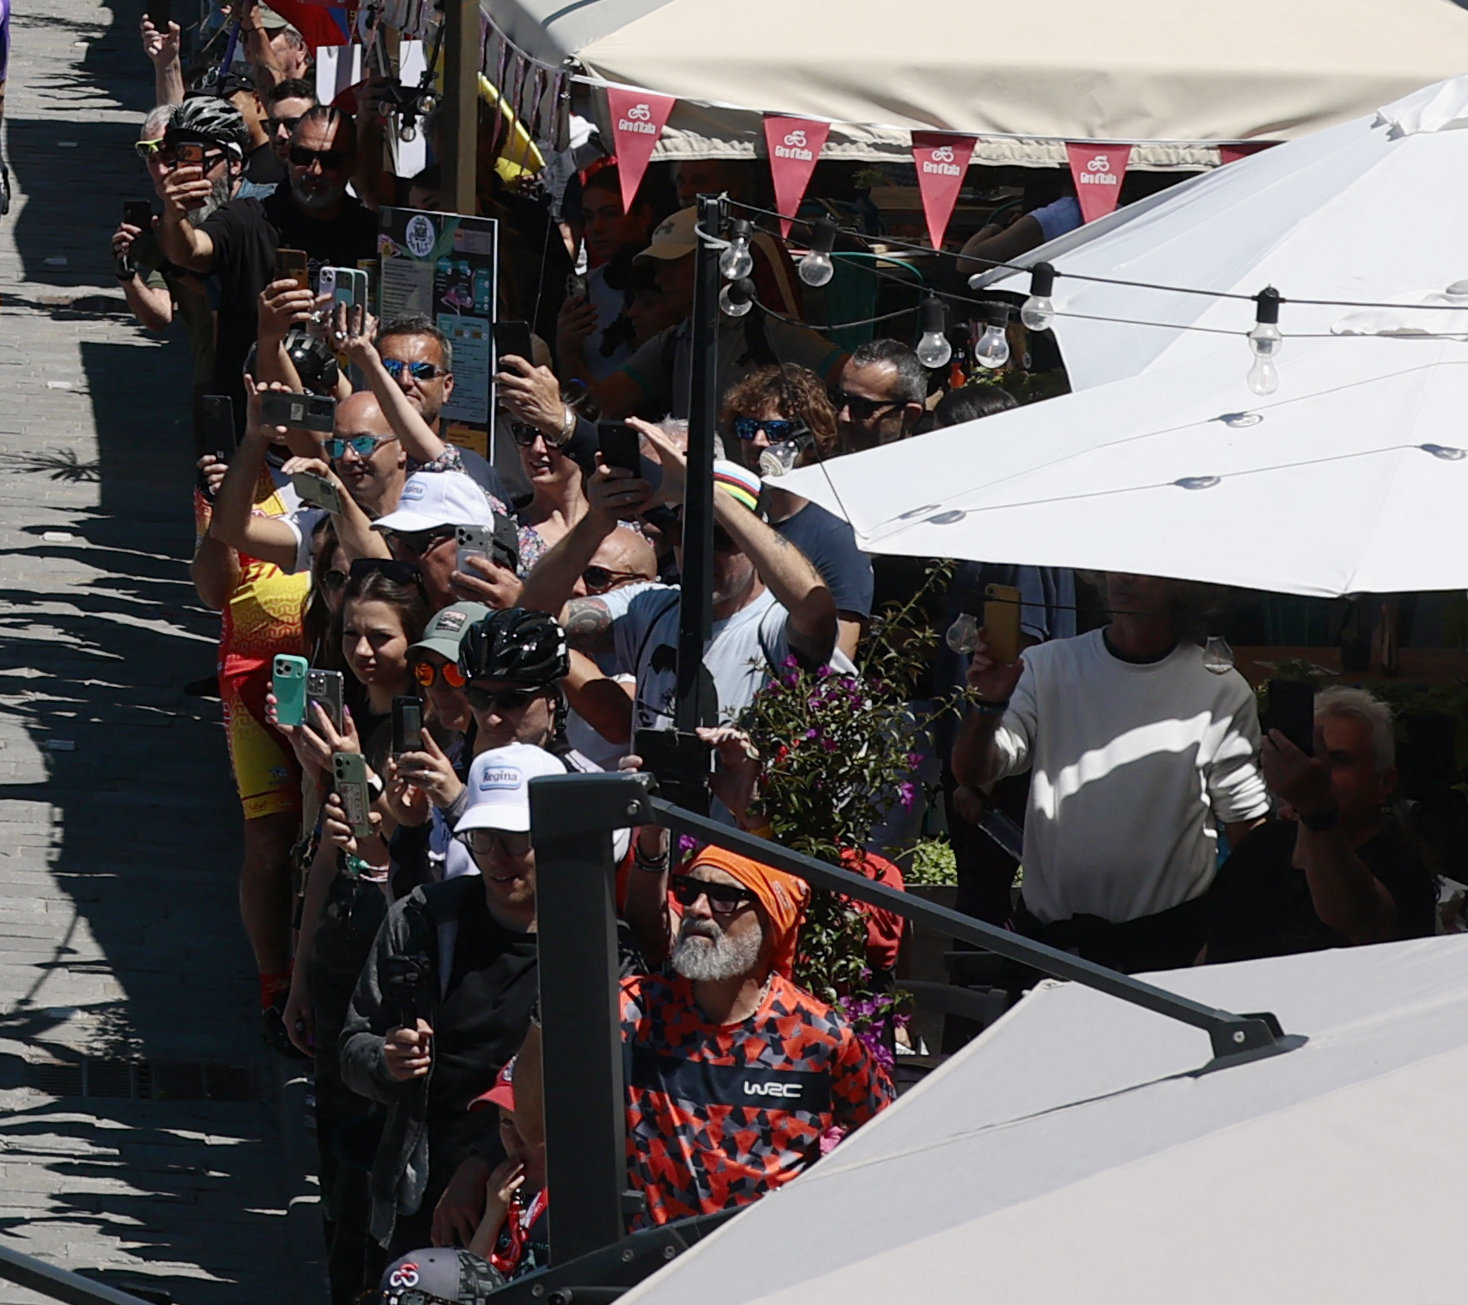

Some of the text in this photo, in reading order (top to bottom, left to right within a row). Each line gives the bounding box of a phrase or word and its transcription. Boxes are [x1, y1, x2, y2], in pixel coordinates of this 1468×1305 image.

[618, 118, 657, 135] Giro d'Italia
[774, 145, 812, 162] Giro d'Italia
[923, 161, 960, 176] Giro d'Italia
[1080, 172, 1117, 185] Giro d'Italia
[482, 765, 518, 784] Regina
[743, 1080, 804, 1098] WRC
